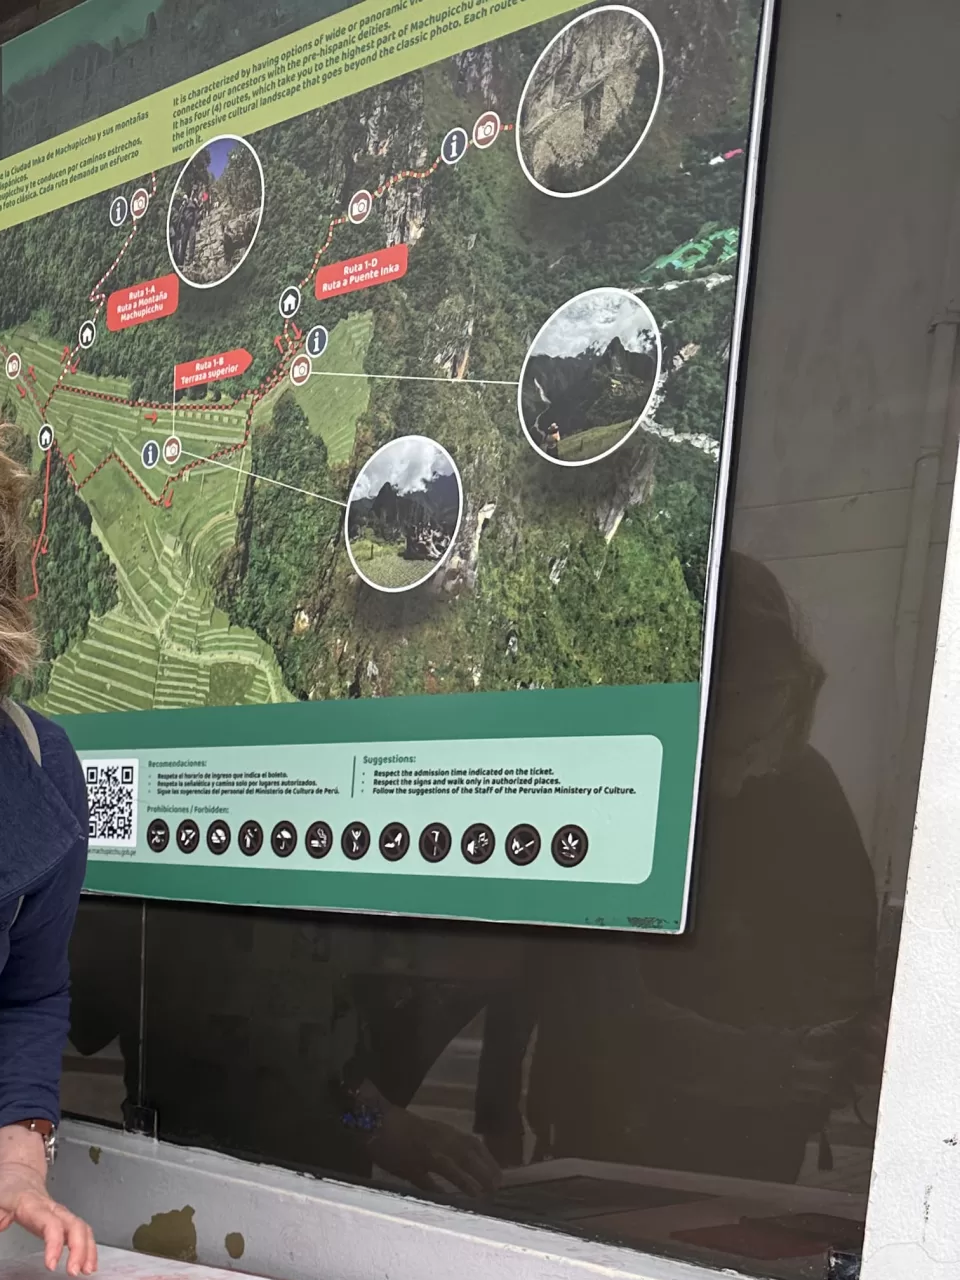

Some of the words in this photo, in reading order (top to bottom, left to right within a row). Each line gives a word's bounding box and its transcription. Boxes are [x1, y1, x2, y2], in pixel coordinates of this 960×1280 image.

[181, 94, 186, 104] is
[188, 70, 240, 101] characterized
[241, 67, 250, 78] by
[252, 55, 279, 74] having
[281, 41, 312, 62] options
[314, 34, 324, 48] of
[326, 26, 346, 43] wide
[348, 22, 357, 33] or
[360, 0, 407, 30] panoramic
[173, 94, 211, 119] connected
[213, 90, 226, 103] our
[228, 73, 266, 96] ancestors
[268, 63, 285, 80] with
[291, 58, 301, 70] the
[303, 35, 355, 67] pre-hispanic
[358, 22, 391, 42] deities.
[173, 130, 185, 142] the
[186, 113, 226, 137] impressive
[228, 98, 258, 120] cultural
[260, 83, 300, 107] landscape
[303, 73, 320, 90] that
[323, 66, 342, 84] goes
[345, 50, 377, 73] beyond
[380, 45, 393, 59] the
[398, 32, 427, 52] classic
[430, 20, 461, 41] photo.
[464, 5, 487, 25] Each
[490, 0, 517, 15] route
[180, 115, 193, 128] has
[194, 108, 210, 122] four
[212, 101, 222, 116] (4)
[224, 93, 250, 110] routes,
[253, 79, 275, 98] which
[278, 73, 295, 88] take
[298, 66, 313, 82] you
[315, 61, 324, 73] to
[326, 55, 339, 68] the
[342, 38, 374, 62] highest
[377, 29, 395, 50] part
[398, 24, 409, 39] of
[411, 0, 473, 34] Machupicchu
[11, 160, 31, 176] Ciudad
[56, 134, 96, 157] Machupicchu
[103, 126, 114, 137] sus
[115, 112, 148, 132] montañas
[173, 136, 194, 154] worth
[37, 168, 66, 186] conducen
[68, 163, 78, 175] por
[80, 152, 106, 169] caminos
[39, 184, 54, 196] Cada
[56, 178, 68, 189] ruta
[70, 166, 98, 184] demanda
[100, 162, 108, 172] un
[110, 150, 139, 168] esfuerzo
[344, 263, 363, 276] Ruta
[365, 257, 378, 270] 1-D
[323, 280, 341, 292] Ruta
[343, 279, 348, 287] a
[350, 269, 379, 285] Puente
[381, 264, 399, 276] Inka
[117, 303, 132, 314] Ruta
[139, 292, 168, 308] Montaña
[129, 290, 144, 301] Ruta
[146, 285, 155, 296] 1-A
[121, 303, 163, 323] Machupicchu
[196, 361, 212, 372] Ruta
[213, 356, 224, 367] 1-B
[181, 372, 207, 385] Terraza
[208, 364, 238, 379] superior
[363, 755, 416, 766] Suggestions:
[373, 778, 399, 787] Respect
[414, 778, 431, 787] signs
[466, 777, 481, 786] only
[483, 777, 490, 785] in
[492, 777, 533, 785] authorized
[534, 777, 560, 786] places.
[374, 769, 400, 778] Respect
[414, 768, 449, 776] admission
[451, 768, 467, 776] time
[469, 768, 503, 776] indicated
[516, 768, 528, 776] the
[530, 768, 554, 776] ticket.
[157, 788, 170, 796] Sigue
[180, 788, 210, 796] sugerencias
[221, 788, 244, 796] personal
[373, 786, 394, 794] Follow
[396, 786, 406, 794] the
[408, 786, 450, 795] suggestions
[452, 786, 459, 794] of
[461, 786, 473, 794] the
[475, 786, 493, 794] Staff
[495, 786, 503, 794] of
[505, 786, 517, 794] the
[519, 786, 553, 794] Peruvian
[554, 787, 591, 795] Ministery
[147, 805, 189, 813] Prohibiciones
